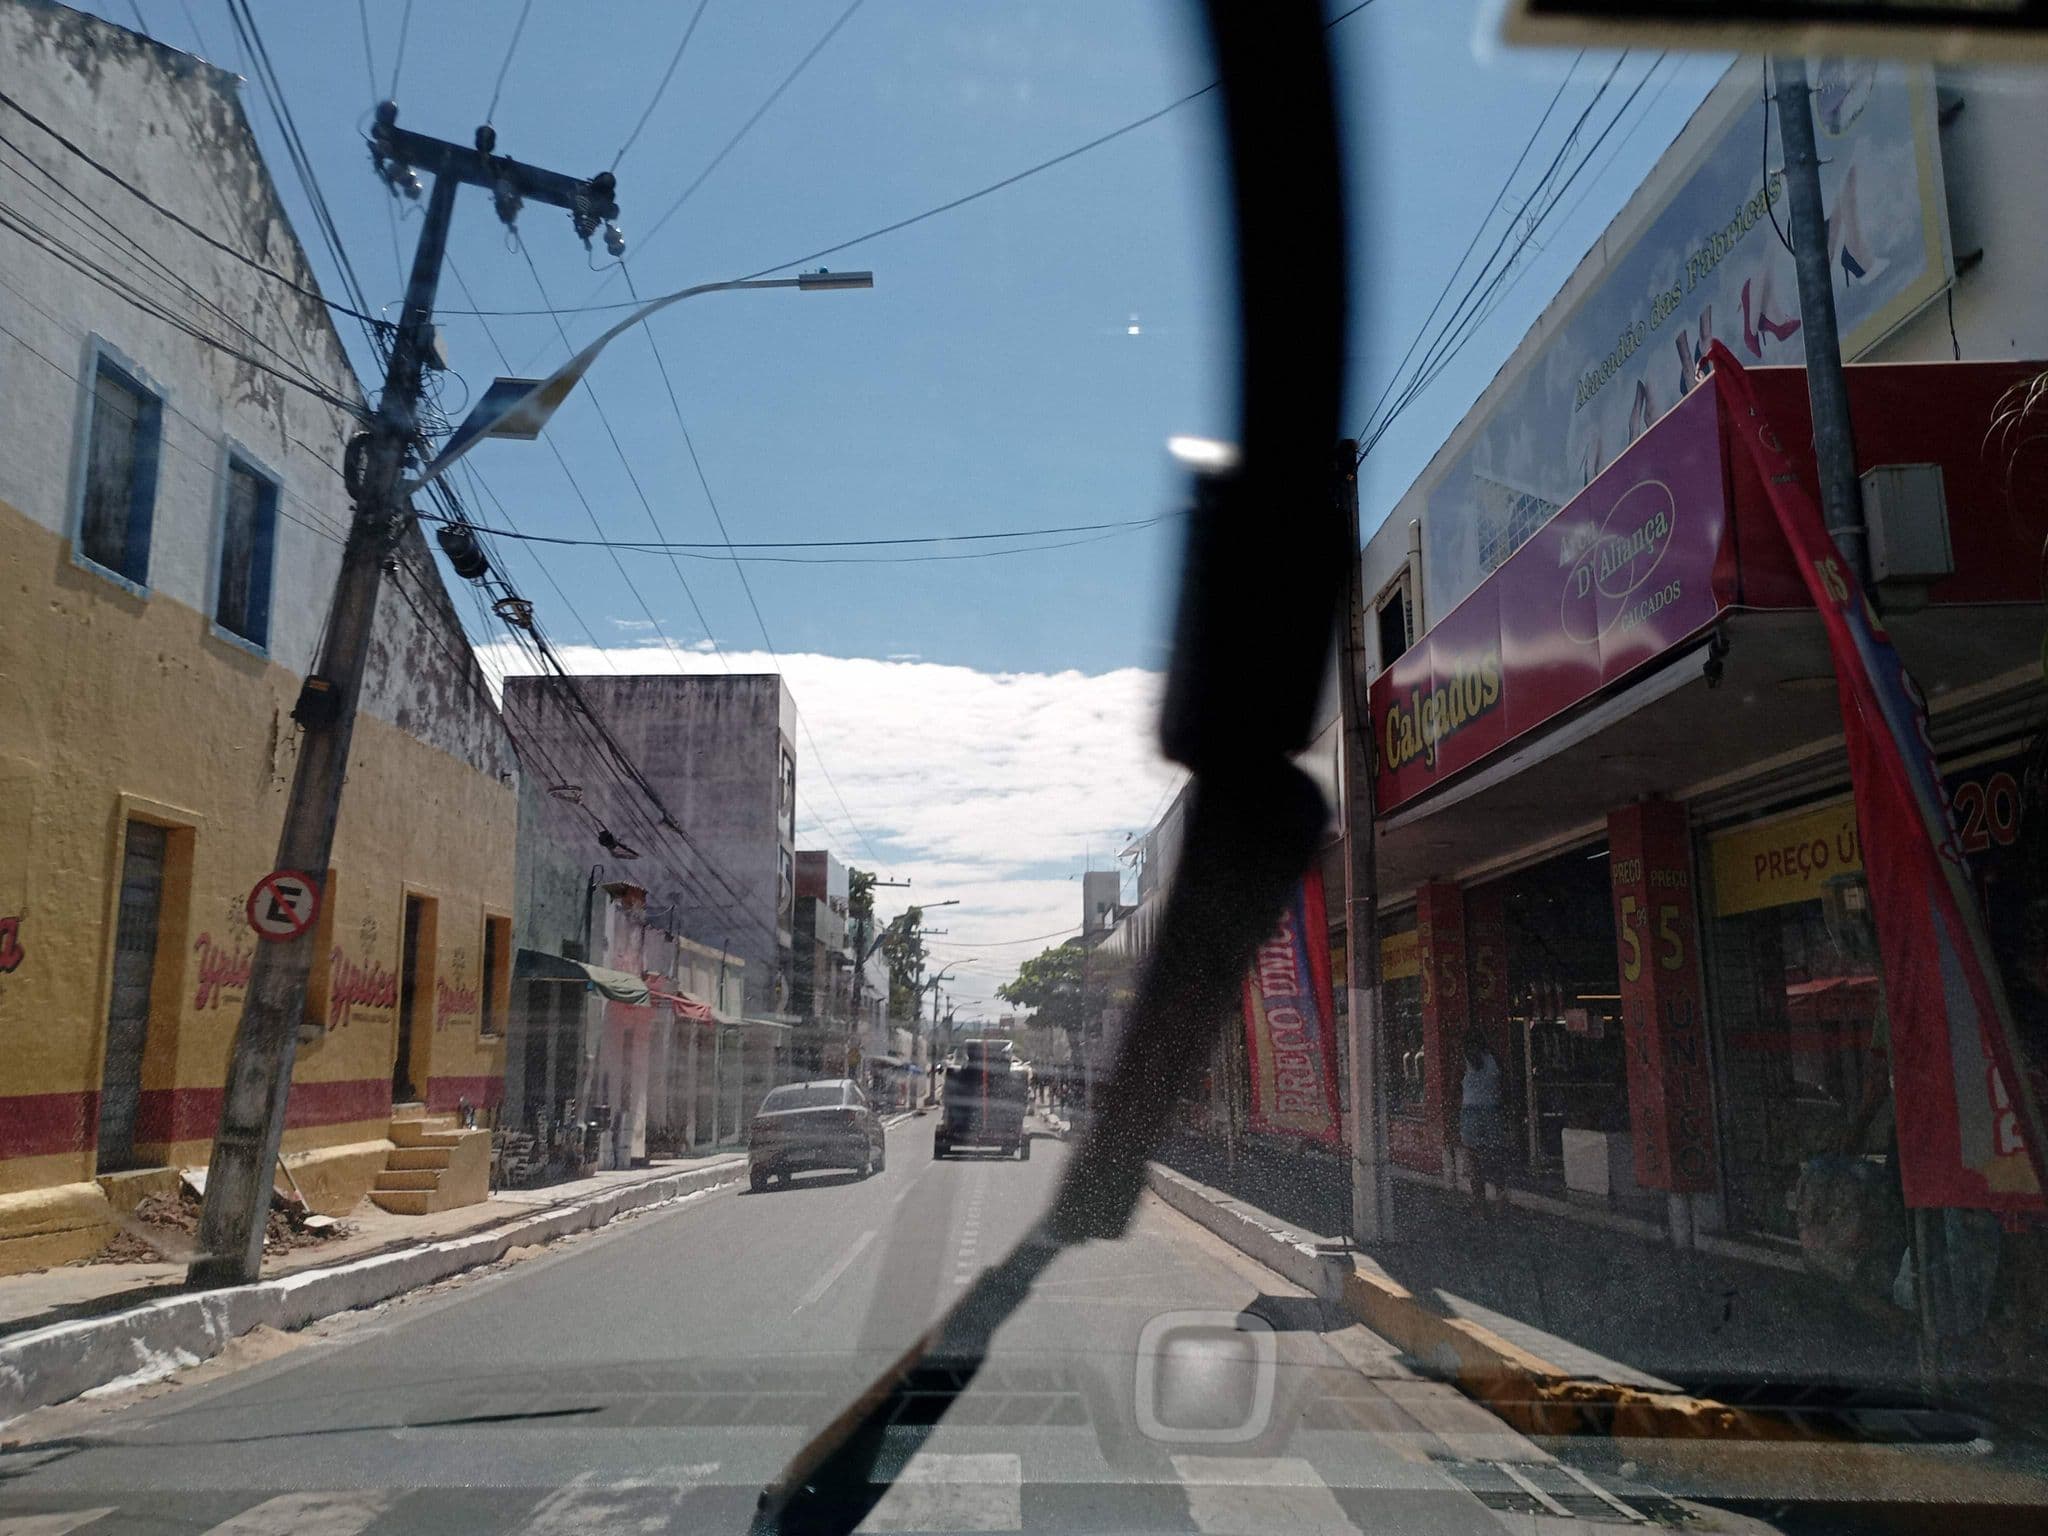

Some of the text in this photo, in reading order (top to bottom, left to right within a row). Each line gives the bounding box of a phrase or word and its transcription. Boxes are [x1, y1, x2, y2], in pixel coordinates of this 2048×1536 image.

[1650, 278, 1682, 332] das
[1385, 650, 1499, 769] Calçados
[1612, 858, 1642, 888] PREÇO
[1754, 838, 1829, 882] PREÇO
[1620, 895, 1642, 983] 5
[1659, 904, 1685, 971] 5
